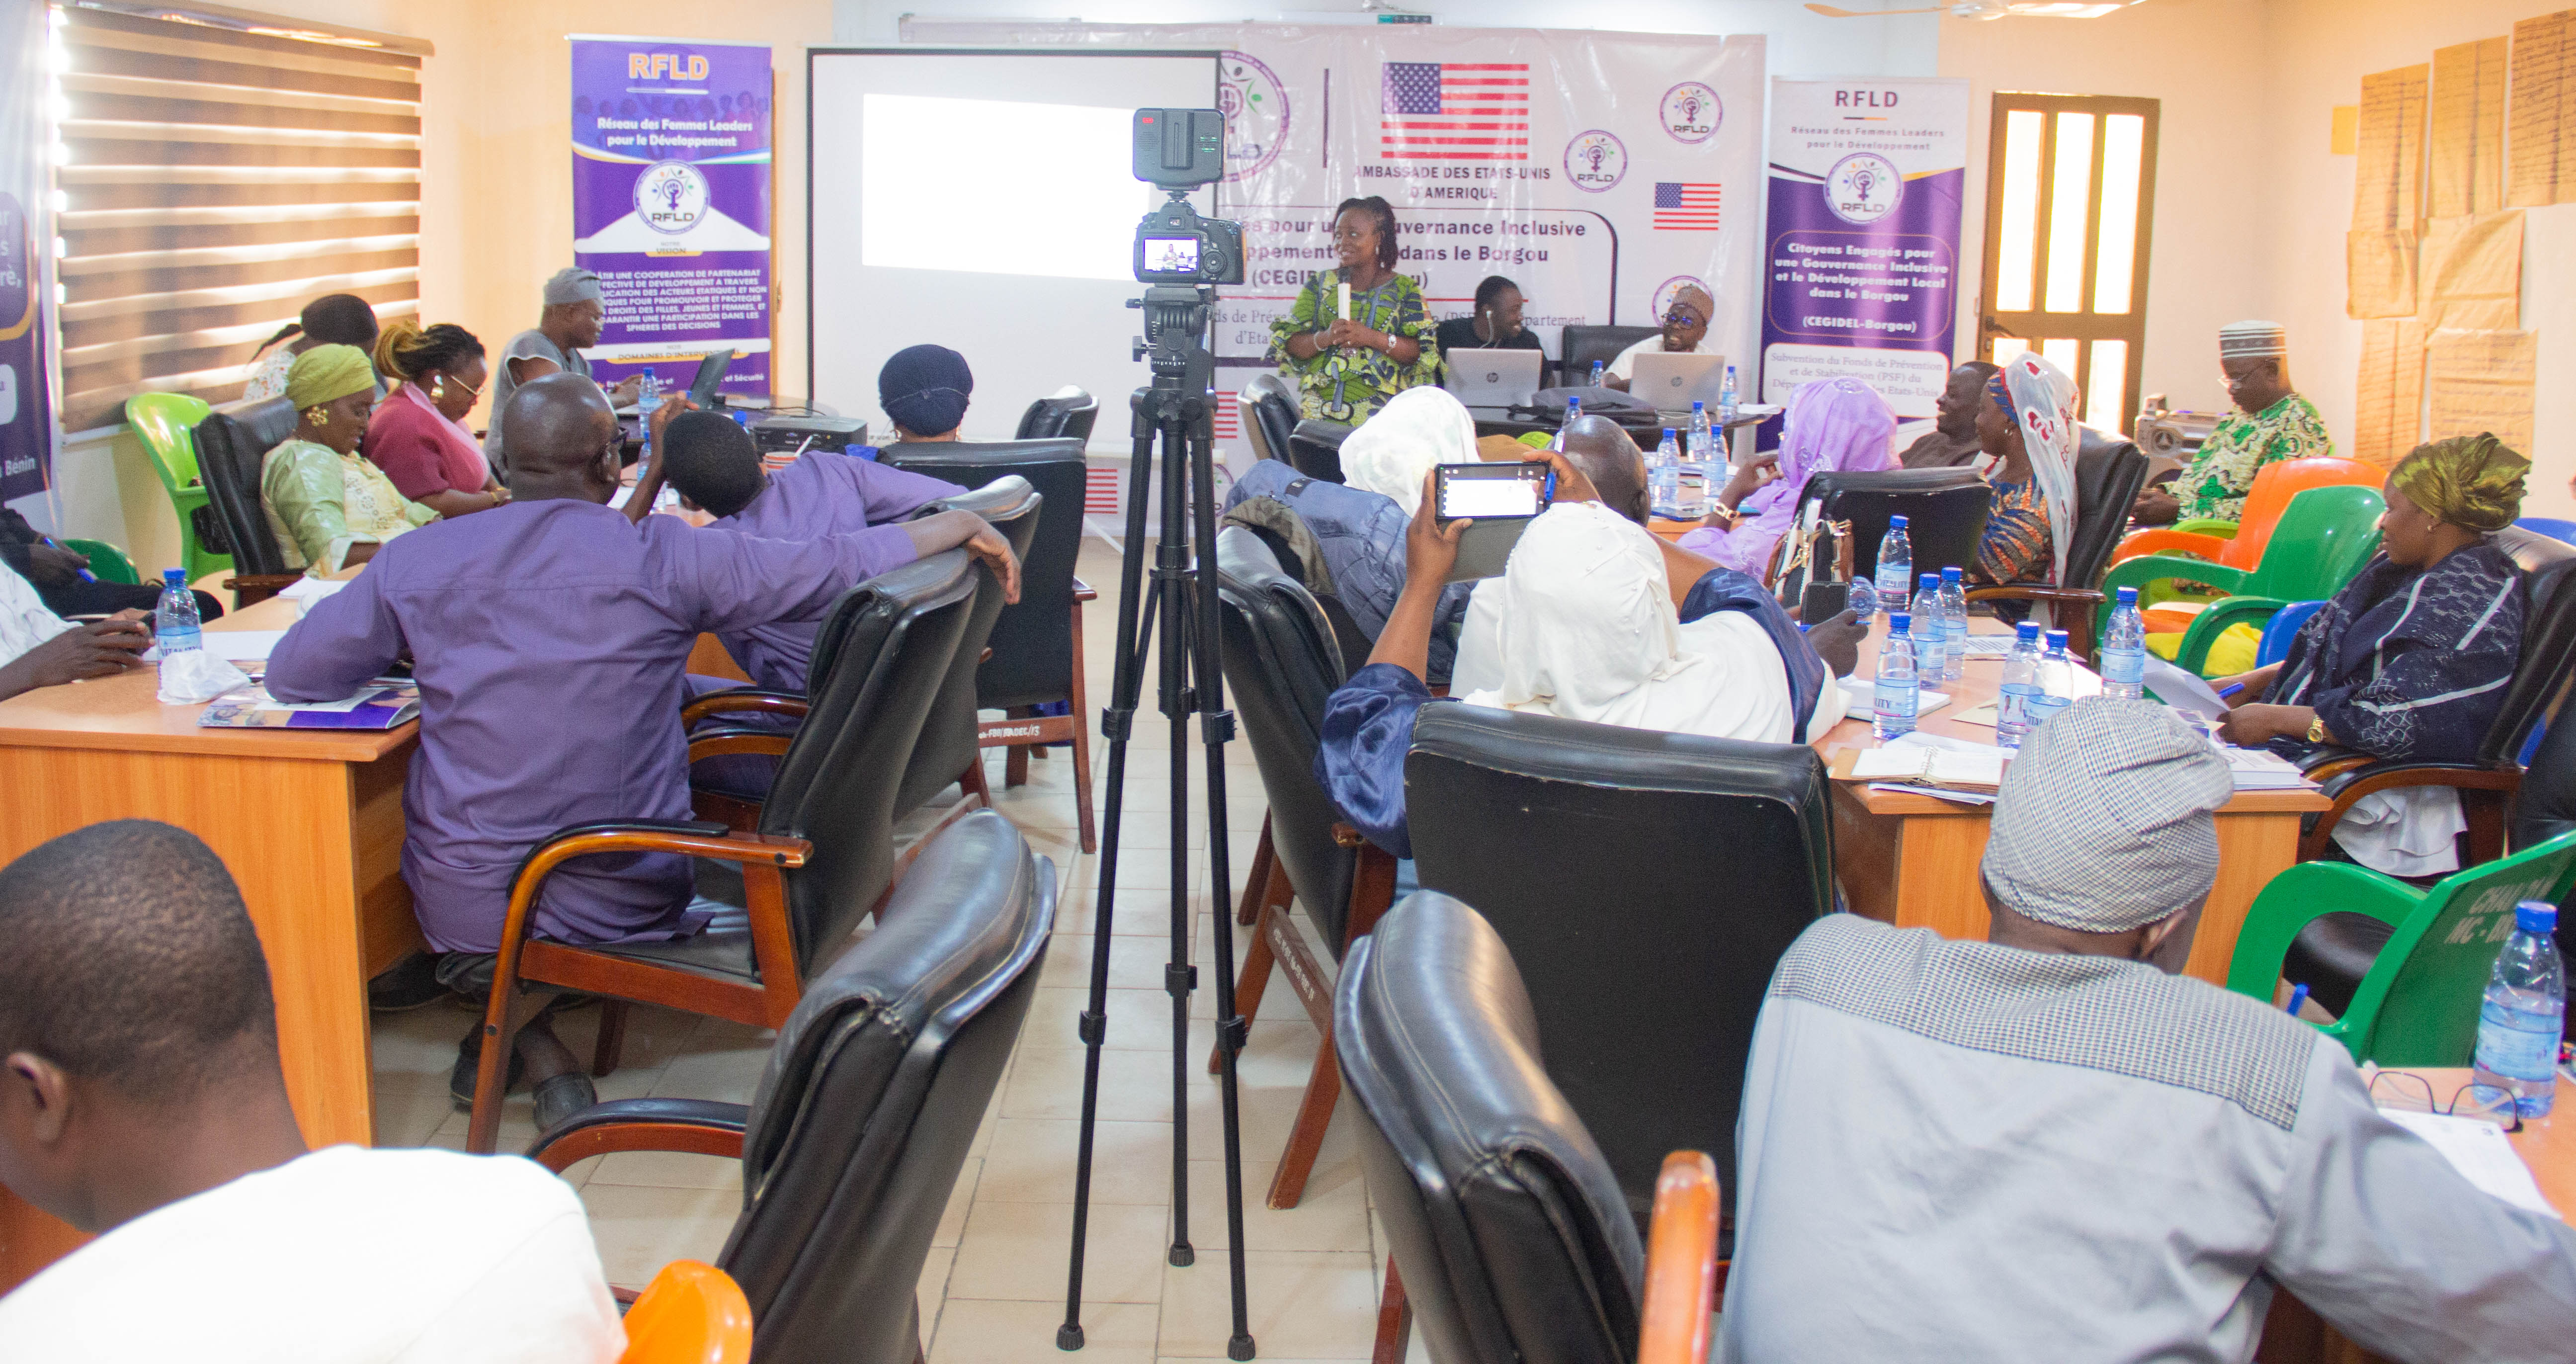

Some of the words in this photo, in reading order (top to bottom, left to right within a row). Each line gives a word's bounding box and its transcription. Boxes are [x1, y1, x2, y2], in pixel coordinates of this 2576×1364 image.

[629, 53, 709, 81] RFLD
[1834, 90, 1898, 107] RFLD
[597, 117, 639, 129] Réseau
[640, 119, 660, 130] des
[662, 118, 708, 130] Femmes
[709, 120, 753, 131] Leaders
[1673, 125, 1709, 134] RFLD
[1791, 126, 1829, 135] Réseau
[1855, 128, 1898, 136] Femmes
[1902, 128, 1944, 137] Leaders
[607, 136, 635, 147] pour
[637, 134, 648, 145] le
[649, 134, 737, 148] Développement
[1807, 141, 1830, 149] pour
[1848, 141, 1930, 150] Développement
[1227, 144, 1262, 159] LD
[1353, 167, 1438, 179] AMBASSADE
[1444, 168, 1469, 178] DES
[1475, 168, 1551, 179] ETATS-UNIS
[1577, 174, 1614, 182] RFLD
[1840, 203, 1885, 213] RFLD
[652, 213, 694, 222] RFLD
[1270, 221, 1313, 235] pour
[1395, 221, 1493, 235] uvernance
[1501, 221, 1585, 236] Inclusive
[1400, 246, 1446, 260] dans
[1454, 246, 1471, 260] le
[1479, 247, 1548, 264] Borgou
[1788, 243, 1842, 255] Citoyens
[1845, 245, 1901, 258] Engagés
[1904, 250, 1935, 259] pour
[1775, 259, 1798, 267] une
[1802, 258, 1886, 271] Gouvernance
[1890, 261, 1948, 273] Inclusive
[1775, 273, 1788, 281] et
[1792, 271, 1804, 282] le
[1808, 272, 1908, 286] Développement
[1911, 277, 1946, 288] Local
[660, 287, 695, 296] ACTEURS
[1810, 287, 1841, 298] dans
[1845, 289, 1857, 299] le
[1861, 289, 1909, 303] Borgou
[654, 296, 710, 305] PROMOUVOIR
[661, 313, 720, 322] PARTICIPATION
[1232, 309, 1246, 322] de
[1523, 315, 1585, 327] partement
[1803, 316, 1916, 333] (CEGIDEL-Borgou)
[1771, 353, 1824, 364] Subvention
[1827, 355, 1839, 364] du
[1843, 356, 1873, 367] Fonds
[1876, 357, 1888, 367] de
[1890, 359, 1943, 371] Prévention
[1801, 367, 1813, 376] de
[1877, 372, 1905, 382] (PSF)
[1908, 374, 1921, 383] du
[5, 455, 35, 476] Bénin
